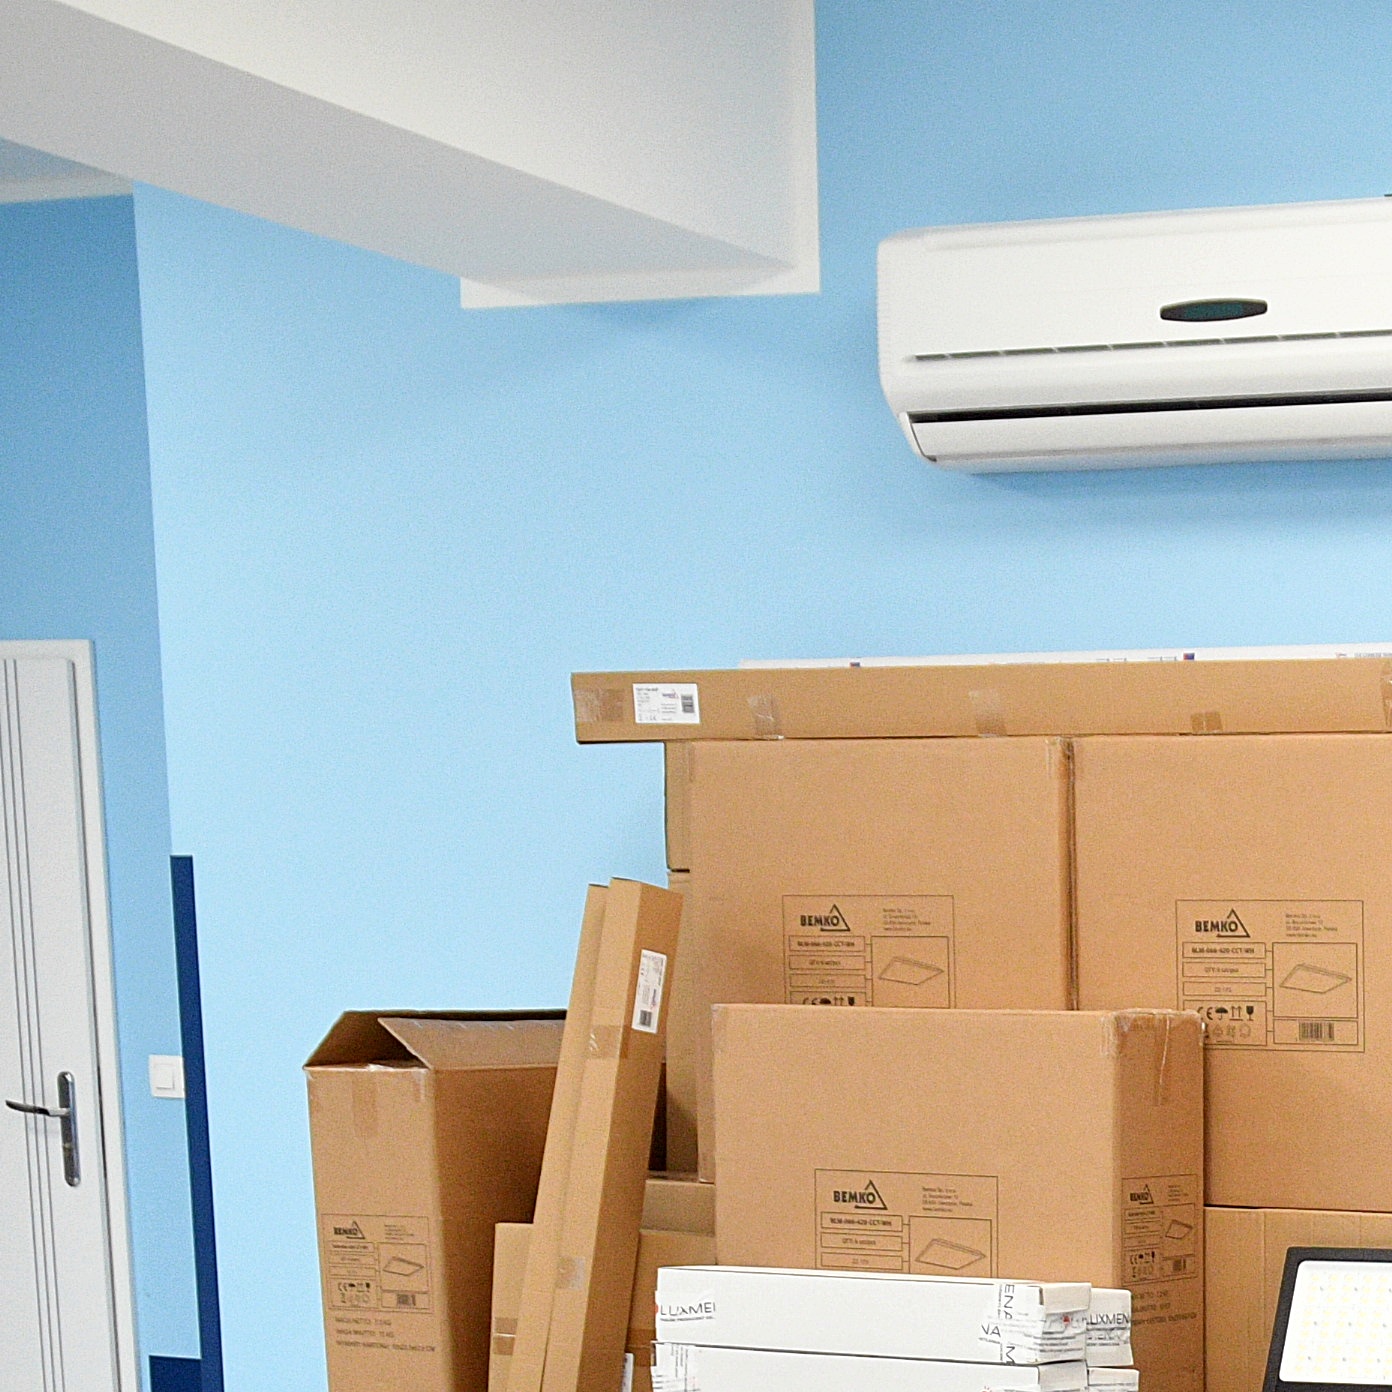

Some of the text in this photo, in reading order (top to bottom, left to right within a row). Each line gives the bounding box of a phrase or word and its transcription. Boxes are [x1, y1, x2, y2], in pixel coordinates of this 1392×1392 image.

[799, 914, 840, 928] BEMKO
[1194, 919, 1239, 933] BEMKO
[832, 1189, 877, 1205] BEMKO
[660, 1301, 716, 1317] LUXME
